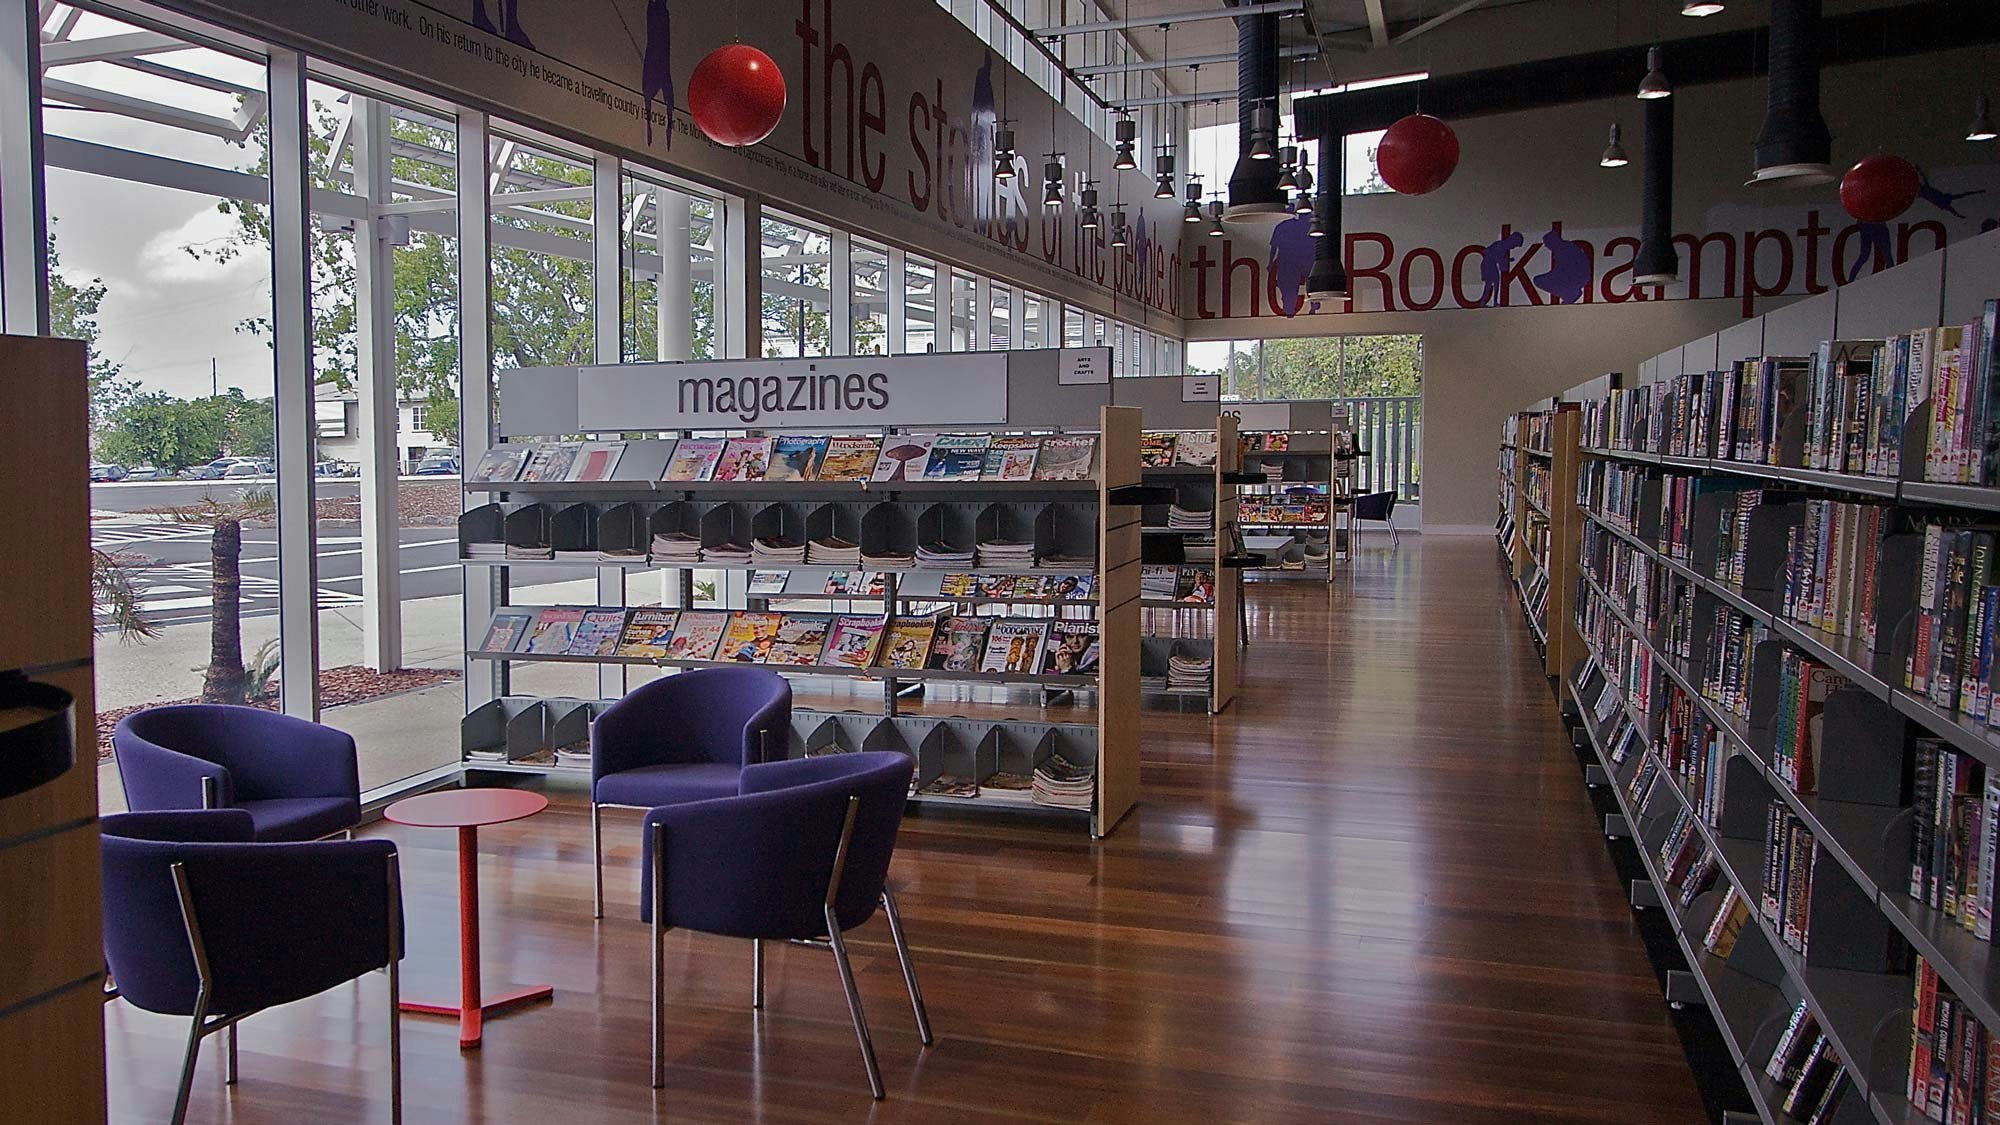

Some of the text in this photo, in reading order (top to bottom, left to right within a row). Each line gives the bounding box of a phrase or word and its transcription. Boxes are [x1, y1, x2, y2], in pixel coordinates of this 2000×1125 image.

[383, 6, 413, 31] work.
[419, 17, 434, 38] On
[437, 23, 451, 45] his
[454, 33, 481, 57] return
[485, 43, 493, 62] to
[495, 48, 510, 68] the
[512, 55, 528, 78] city
[530, 60, 541, 80] he
[542, 68, 574, 92] became
[575, 82, 580, 95] a
[614, 96, 641, 121] country
[676, 117, 688, 135] The
[795, 0, 886, 193] the
[1113, 220, 1165, 324] people
[1169, 238, 1182, 318] of
[1344, 210, 1947, 318] Rockhampton
[678, 365, 890, 423] magazines
[779, 436, 827, 447] Photography
[990, 441, 1040, 451] Keepsakes
[1928, 536, 1941, 599] NICHOLAS
[1973, 601, 1986, 658] SHADOW PLAY
[1937, 1000, 1951, 1064] MICHAEL CONNELLY
